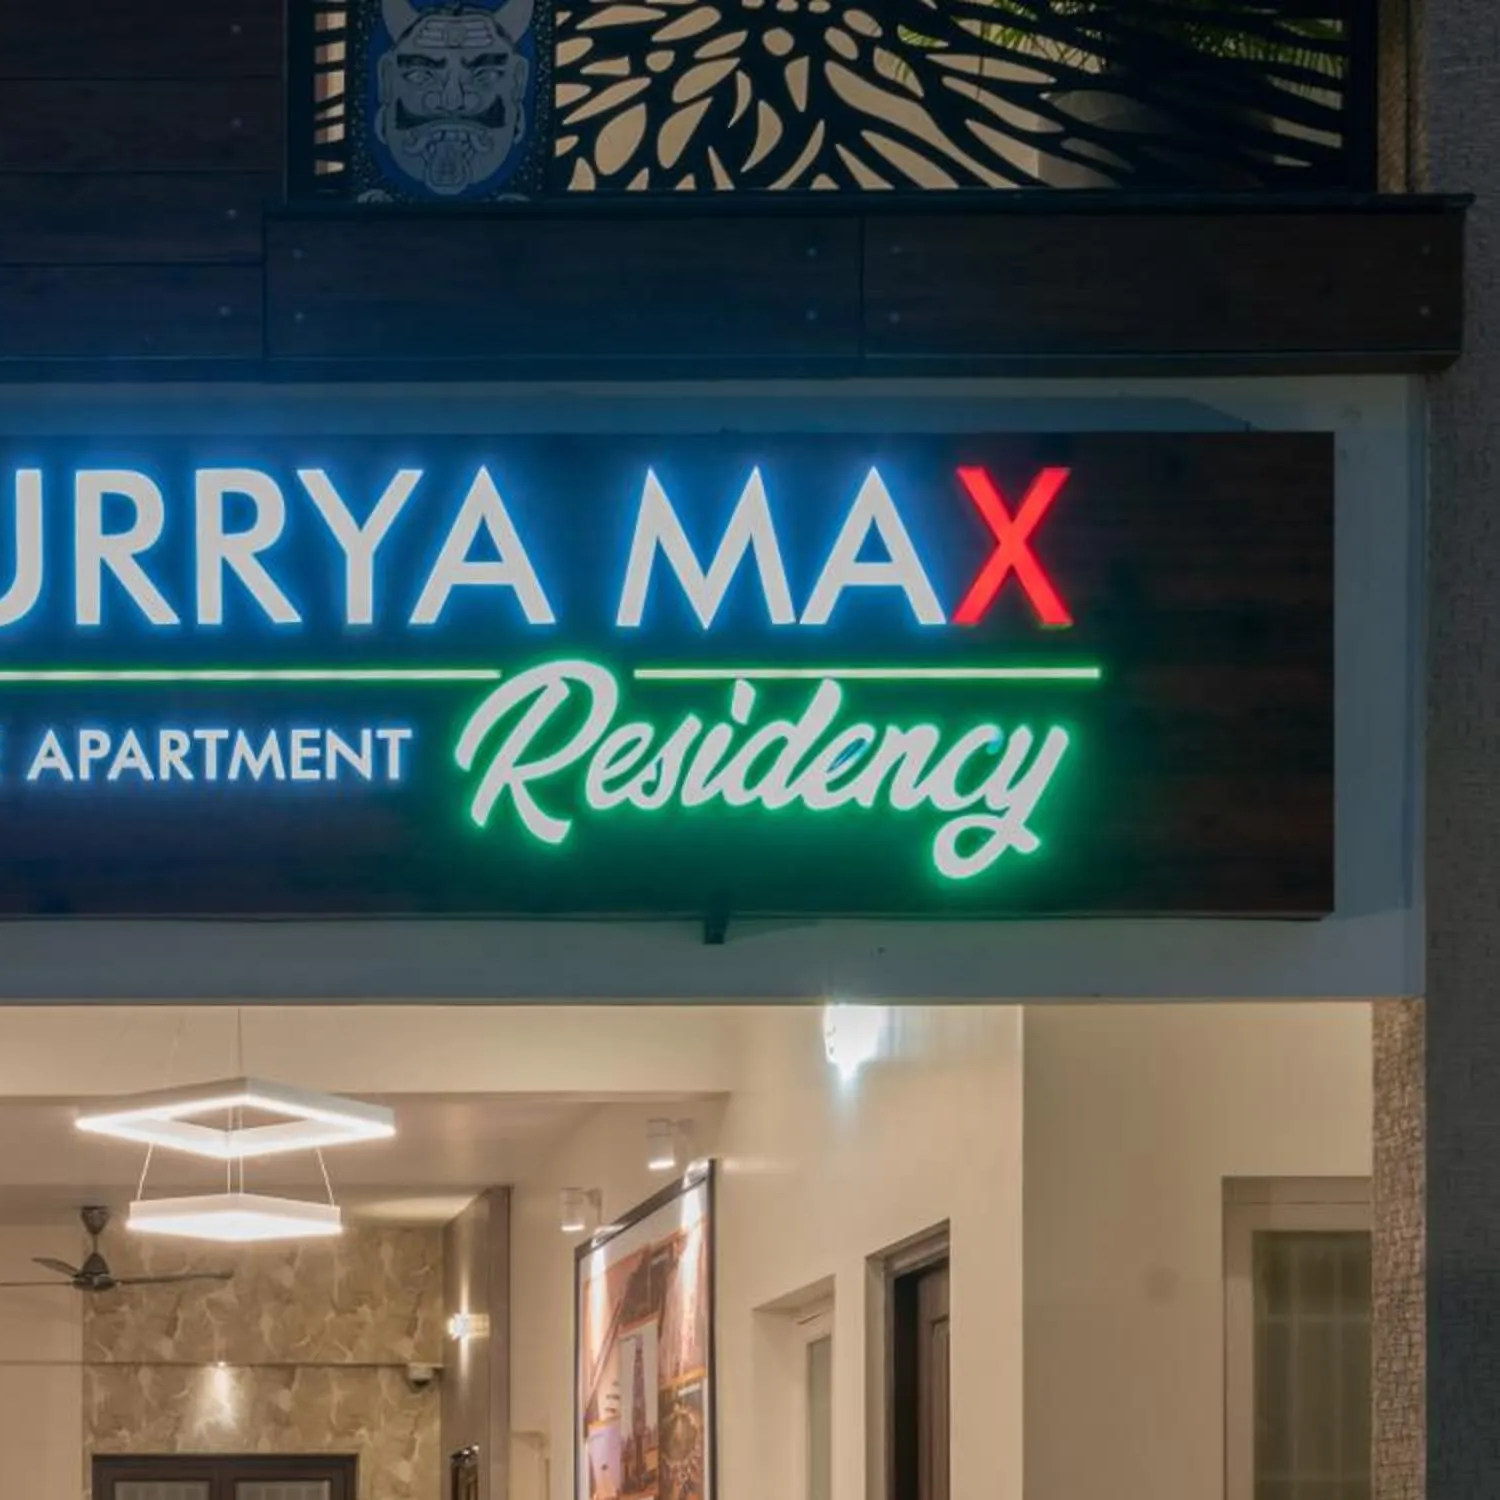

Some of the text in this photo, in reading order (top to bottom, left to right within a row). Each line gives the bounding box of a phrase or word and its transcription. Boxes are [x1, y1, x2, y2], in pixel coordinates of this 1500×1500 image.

[616, 466, 1071, 628] MAX
[27, 729, 411, 781] APARTMENT
[455, 660, 1069, 879] Residency
